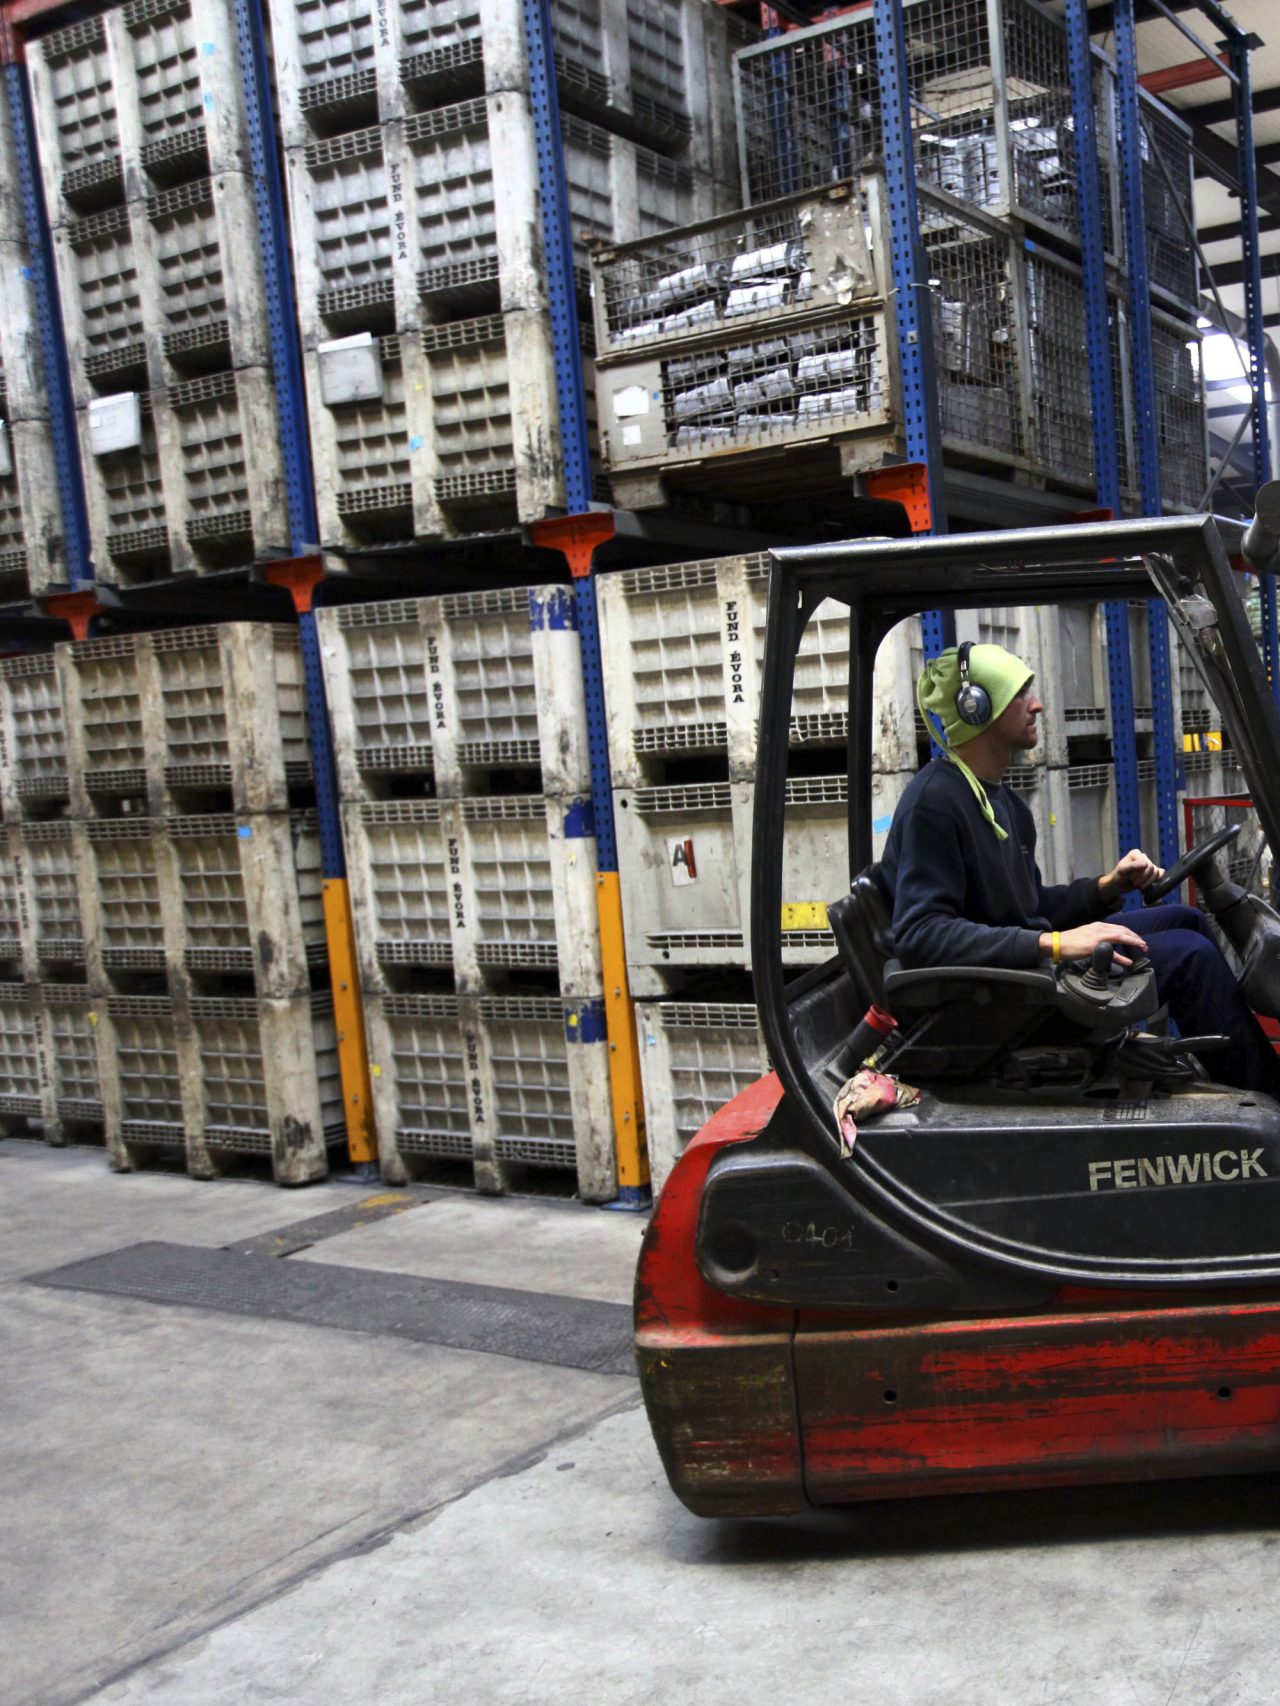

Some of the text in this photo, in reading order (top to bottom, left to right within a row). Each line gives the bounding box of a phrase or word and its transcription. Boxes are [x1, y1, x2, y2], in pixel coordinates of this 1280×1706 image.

[391, 164, 402, 202] FUND
[427, 637, 439, 673] FUND
[726, 601, 744, 703] FUND ÉVORA
[448, 838, 460, 874] FUND
[466, 1034, 478, 1070] FUND
[1088, 1147, 1268, 1192] FENWICK
